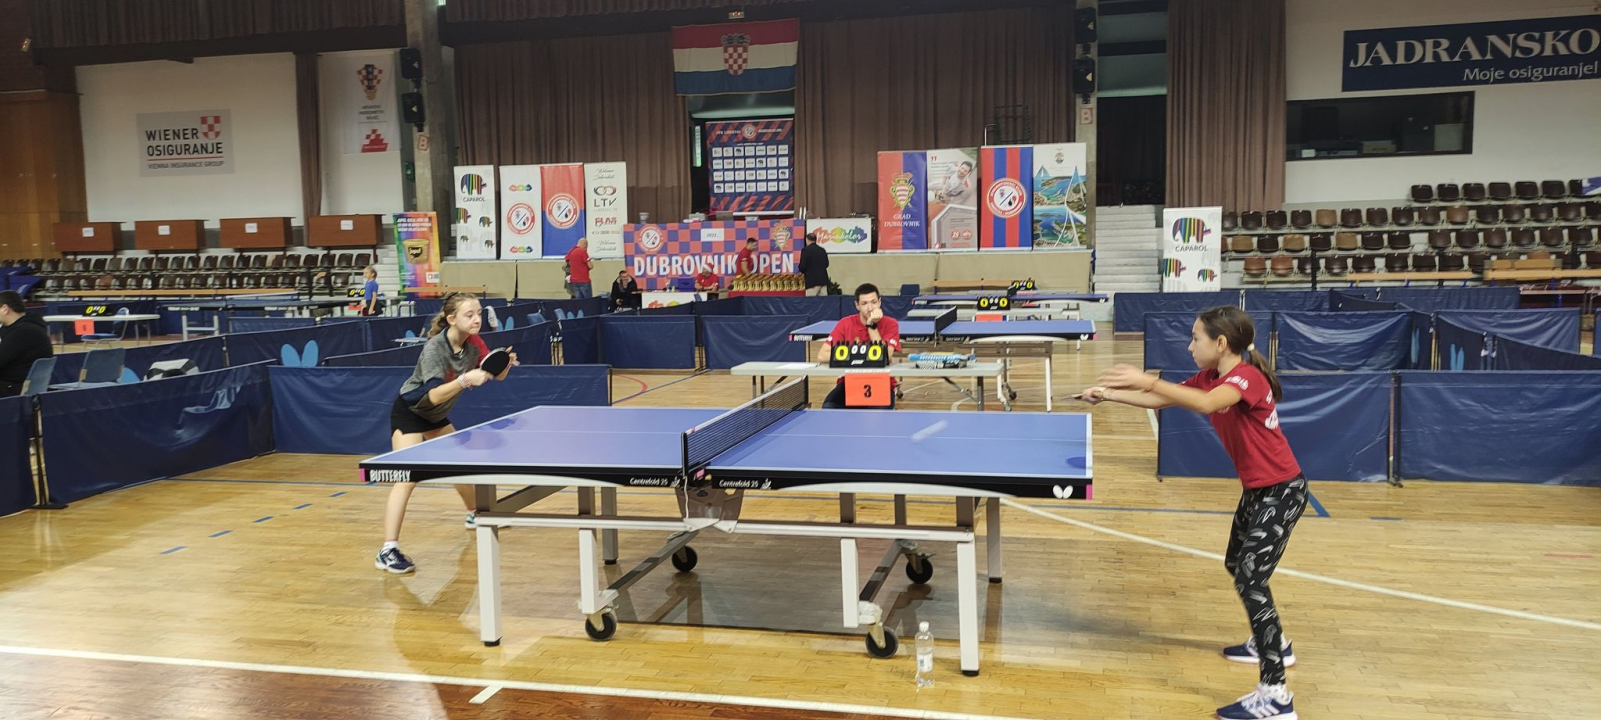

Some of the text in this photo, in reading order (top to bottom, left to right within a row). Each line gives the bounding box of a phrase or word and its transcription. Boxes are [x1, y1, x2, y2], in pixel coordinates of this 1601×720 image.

[1349, 28, 1600, 68] JADRANSKO
[1463, 61, 1599, 84] Moje osiguranje!
[1080, 108, 1092, 125] B
[145, 128, 200, 142] WIENER
[147, 142, 224, 157] OSIGURANJE
[419, 136, 429, 150] B
[170, 161, 203, 169] INSURANCE
[204, 160, 225, 168] GROUP
[593, 197, 617, 208] LTV
[884, 220, 921, 228] DUBROVNIK
[1175, 245, 1208, 253] CAPAROL
[634, 253, 739, 277] DUBROVNIK
[980, 297, 988, 308] 0
[1000, 297, 1008, 308] 0
[834, 344, 882, 361] 0 0 0 0
[863, 384, 872, 399] 3
[369, 469, 411, 483] BUTTERFLY
[629, 477, 660, 486] Centrefold
[719, 479, 750, 488] Centrefold
